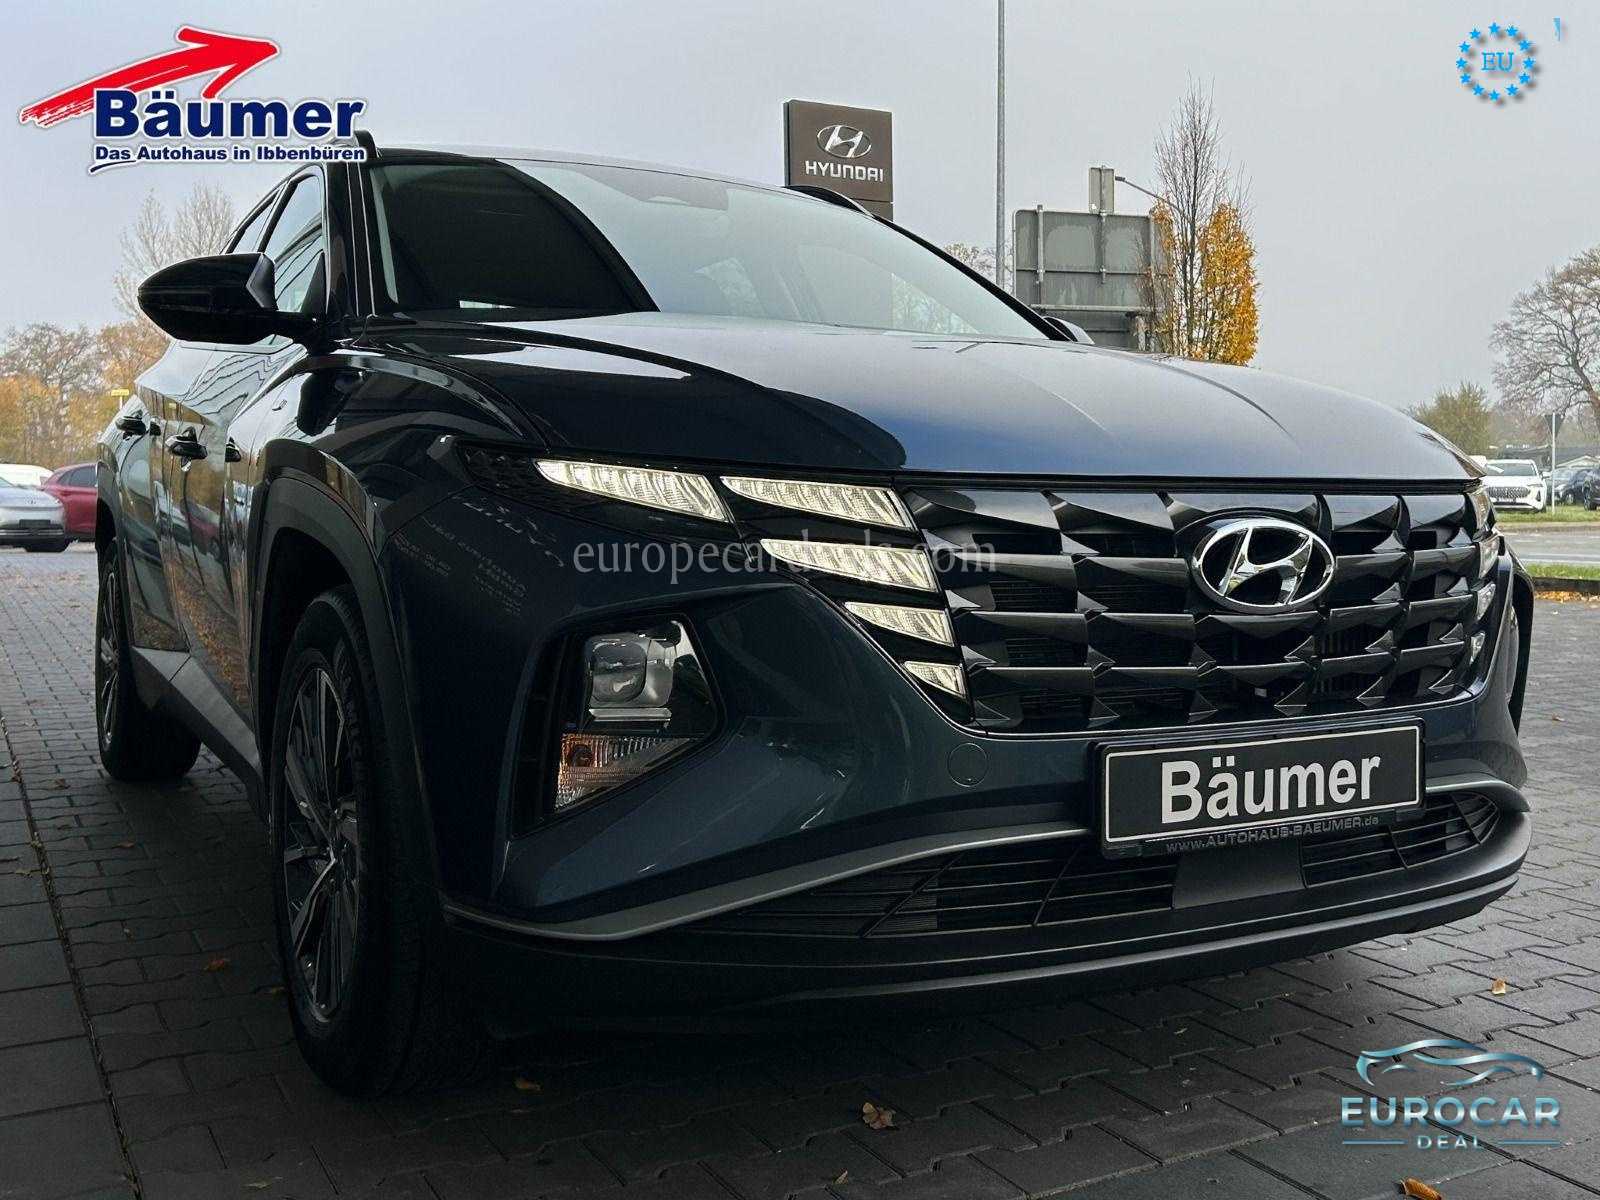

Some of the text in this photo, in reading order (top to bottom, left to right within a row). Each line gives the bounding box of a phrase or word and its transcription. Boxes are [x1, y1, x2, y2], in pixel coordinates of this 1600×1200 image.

[805, 160, 884, 182] HYUNDAI
[1161, 755, 1382, 824] Bäumer
[1166, 815, 1379, 852] www.AUTOHAUS-BAEUMER.de
